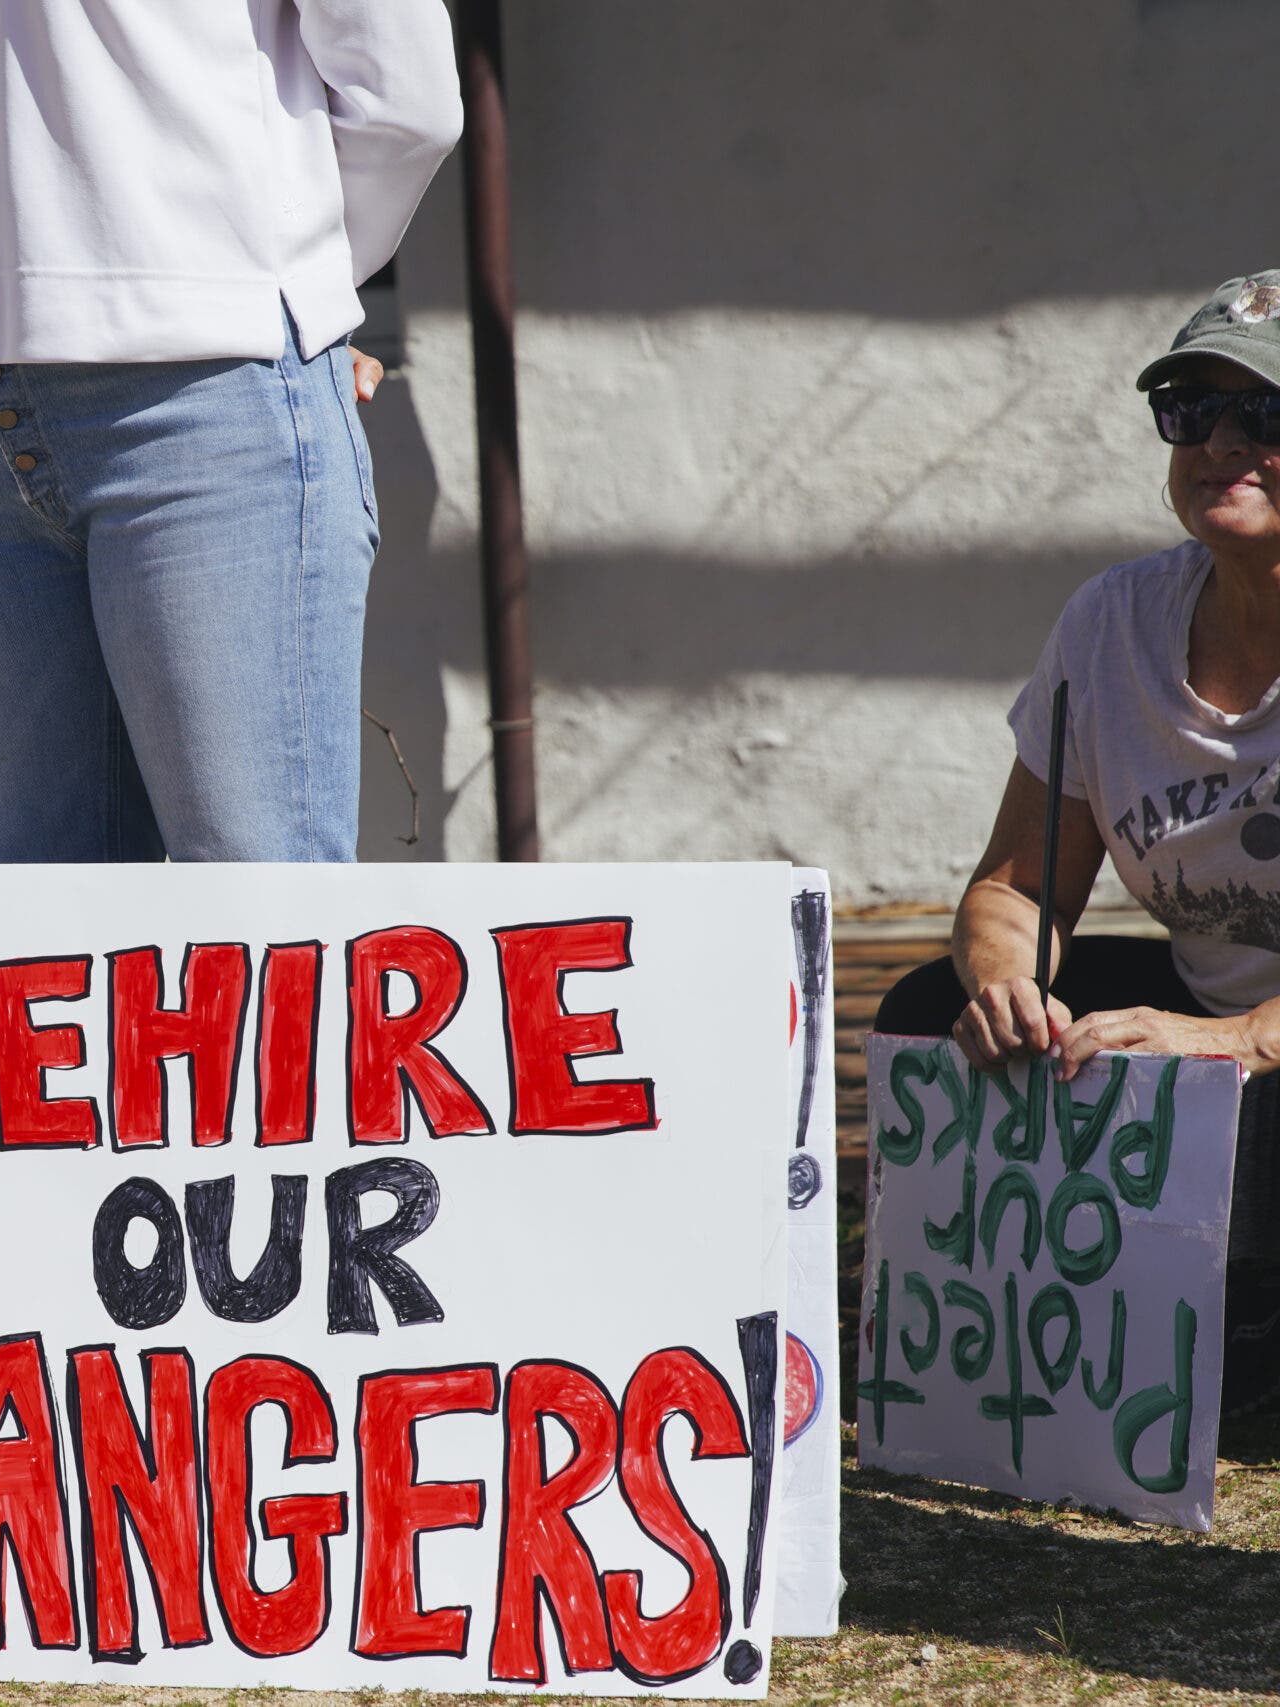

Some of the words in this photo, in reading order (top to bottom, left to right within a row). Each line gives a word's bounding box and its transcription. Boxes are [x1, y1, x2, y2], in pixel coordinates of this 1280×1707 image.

[1113, 772, 1229, 861] TAKE
[877, 1038, 1182, 1211] PARKS
[92, 1156, 445, 1336] OUR
[857, 1258, 1197, 1494] Protect
